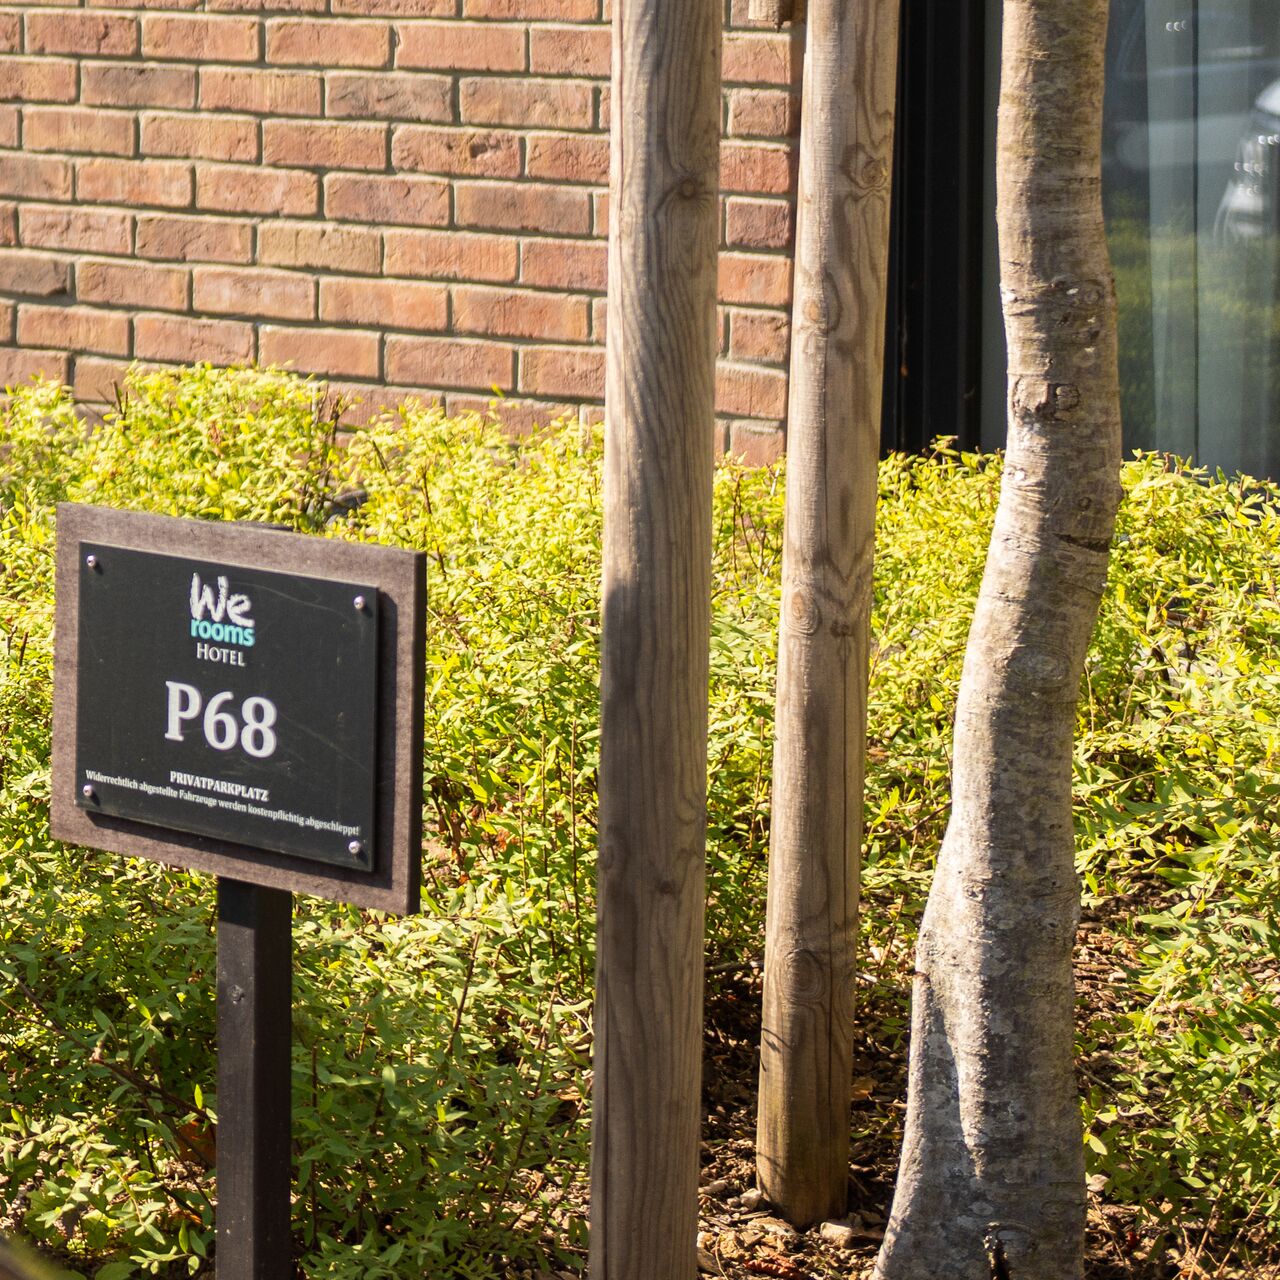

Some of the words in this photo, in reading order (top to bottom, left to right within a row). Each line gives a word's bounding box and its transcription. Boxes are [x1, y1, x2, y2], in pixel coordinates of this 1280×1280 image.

[190, 572, 256, 628] We
[190, 618, 256, 648] rooms
[196, 642, 246, 667] HOTEL
[165, 680, 278, 758] P68
[85, 769, 138, 790] Widerrechtlich
[139, 781, 178, 799] abgestellte
[179, 789, 217, 808] Fahrzeuge
[218, 799, 247, 813] werden
[247, 803, 304, 826] kostenpflichtig
[305, 816, 360, 837] abgeschleppt!
[169, 770, 269, 802] PRIVATPARKPLATZ
